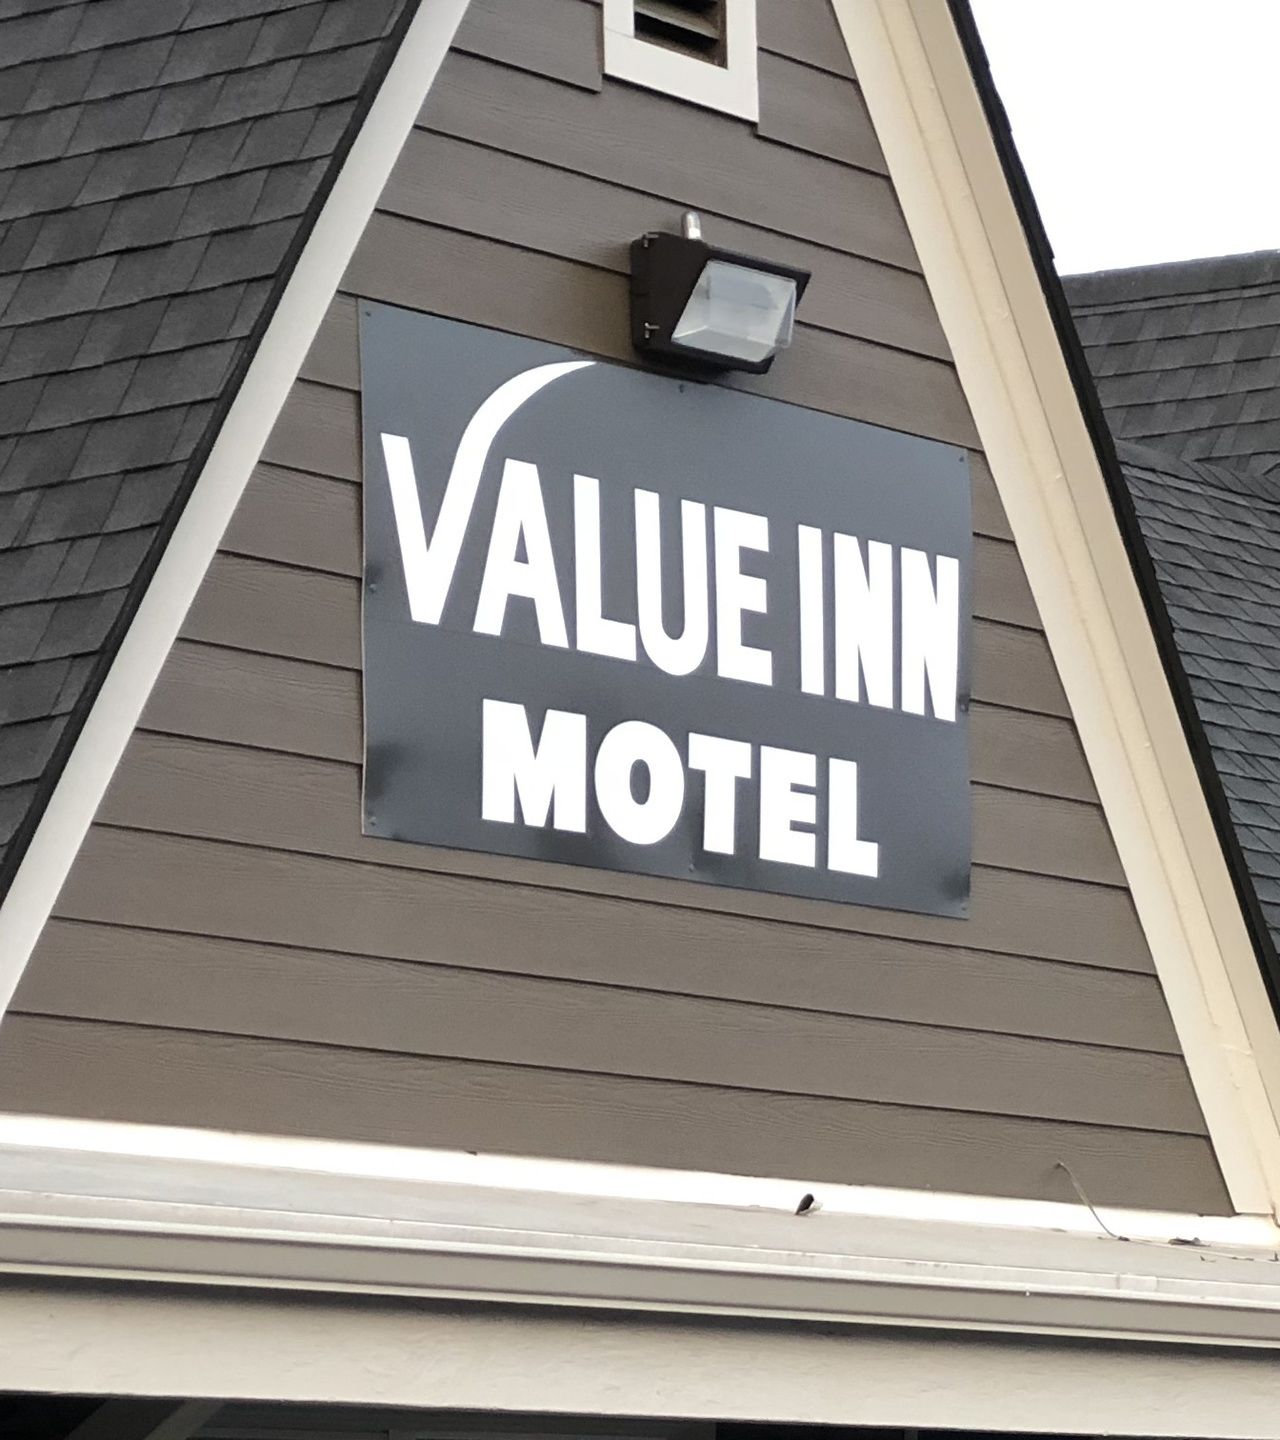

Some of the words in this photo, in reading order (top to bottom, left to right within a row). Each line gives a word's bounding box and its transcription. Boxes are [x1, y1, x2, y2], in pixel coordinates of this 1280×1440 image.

[380, 361, 774, 687] VALUE
[797, 524, 960, 723] INN
[481, 698, 879, 878] MOTEL
